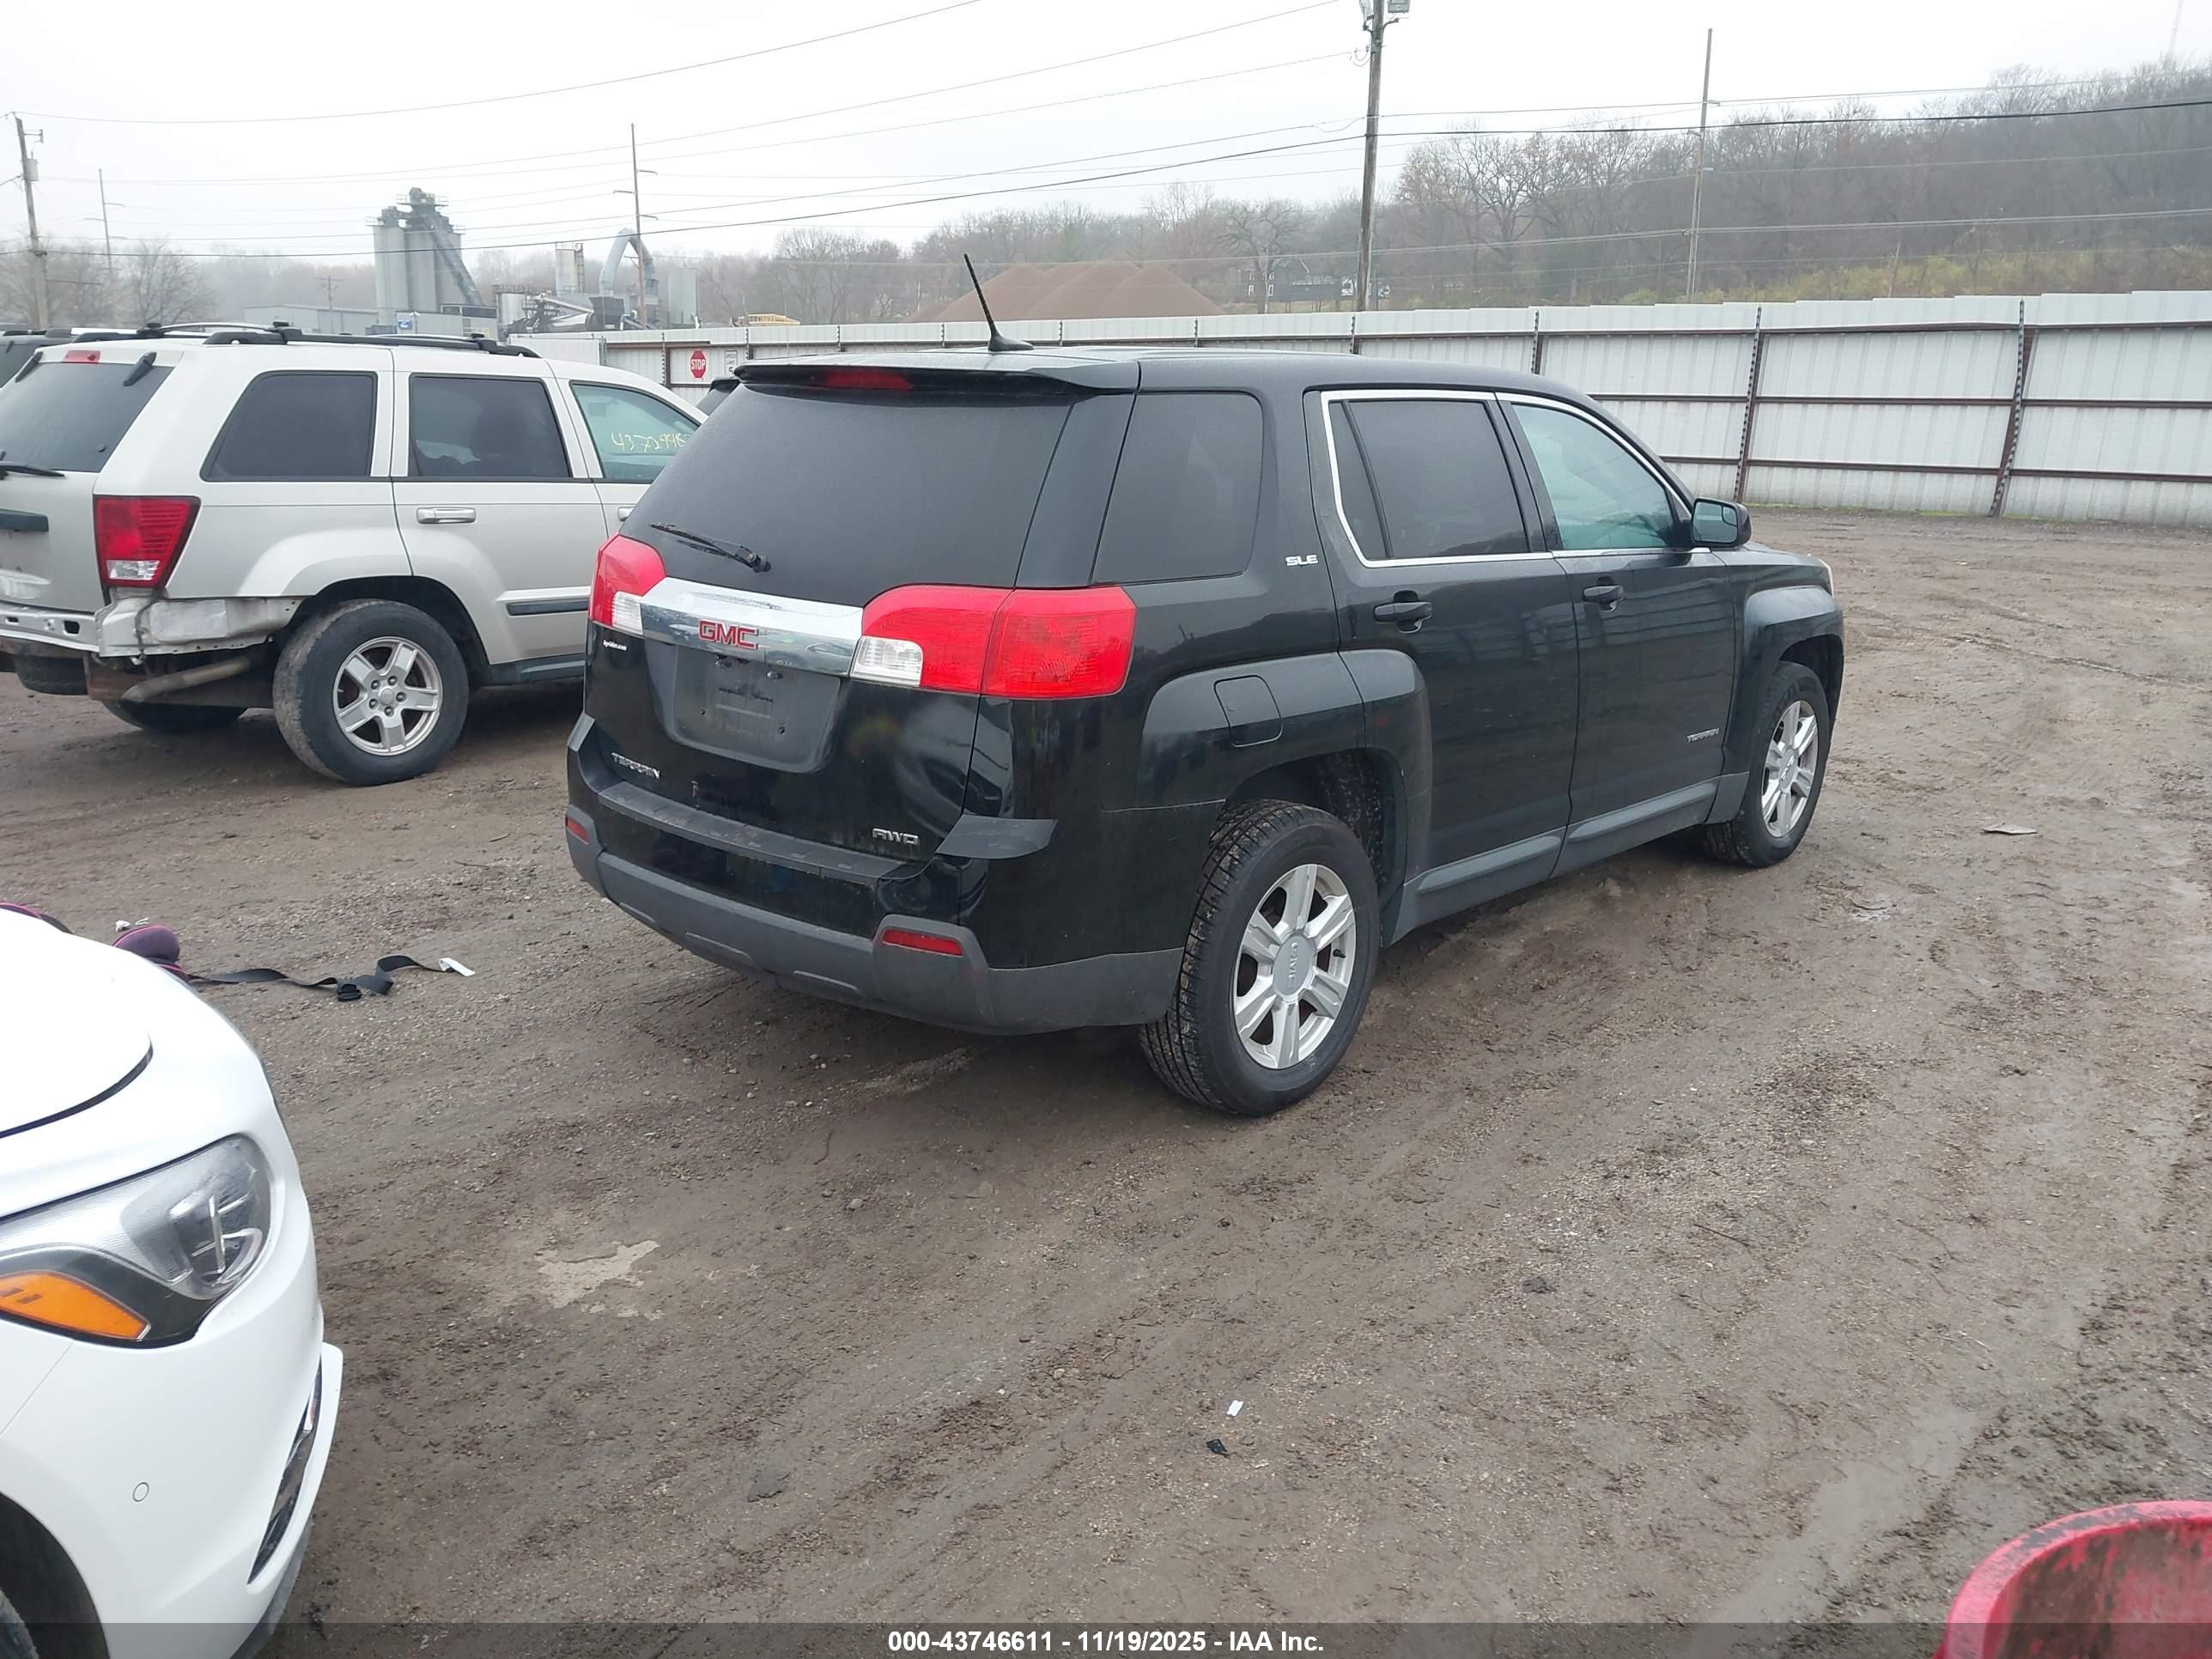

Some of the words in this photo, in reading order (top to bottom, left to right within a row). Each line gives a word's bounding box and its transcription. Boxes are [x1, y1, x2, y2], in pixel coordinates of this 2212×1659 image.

[691, 358, 706, 371] STOP
[1285, 554, 1319, 567] SLE
[699, 619, 759, 650] GMC
[872, 828, 919, 845] AWD
